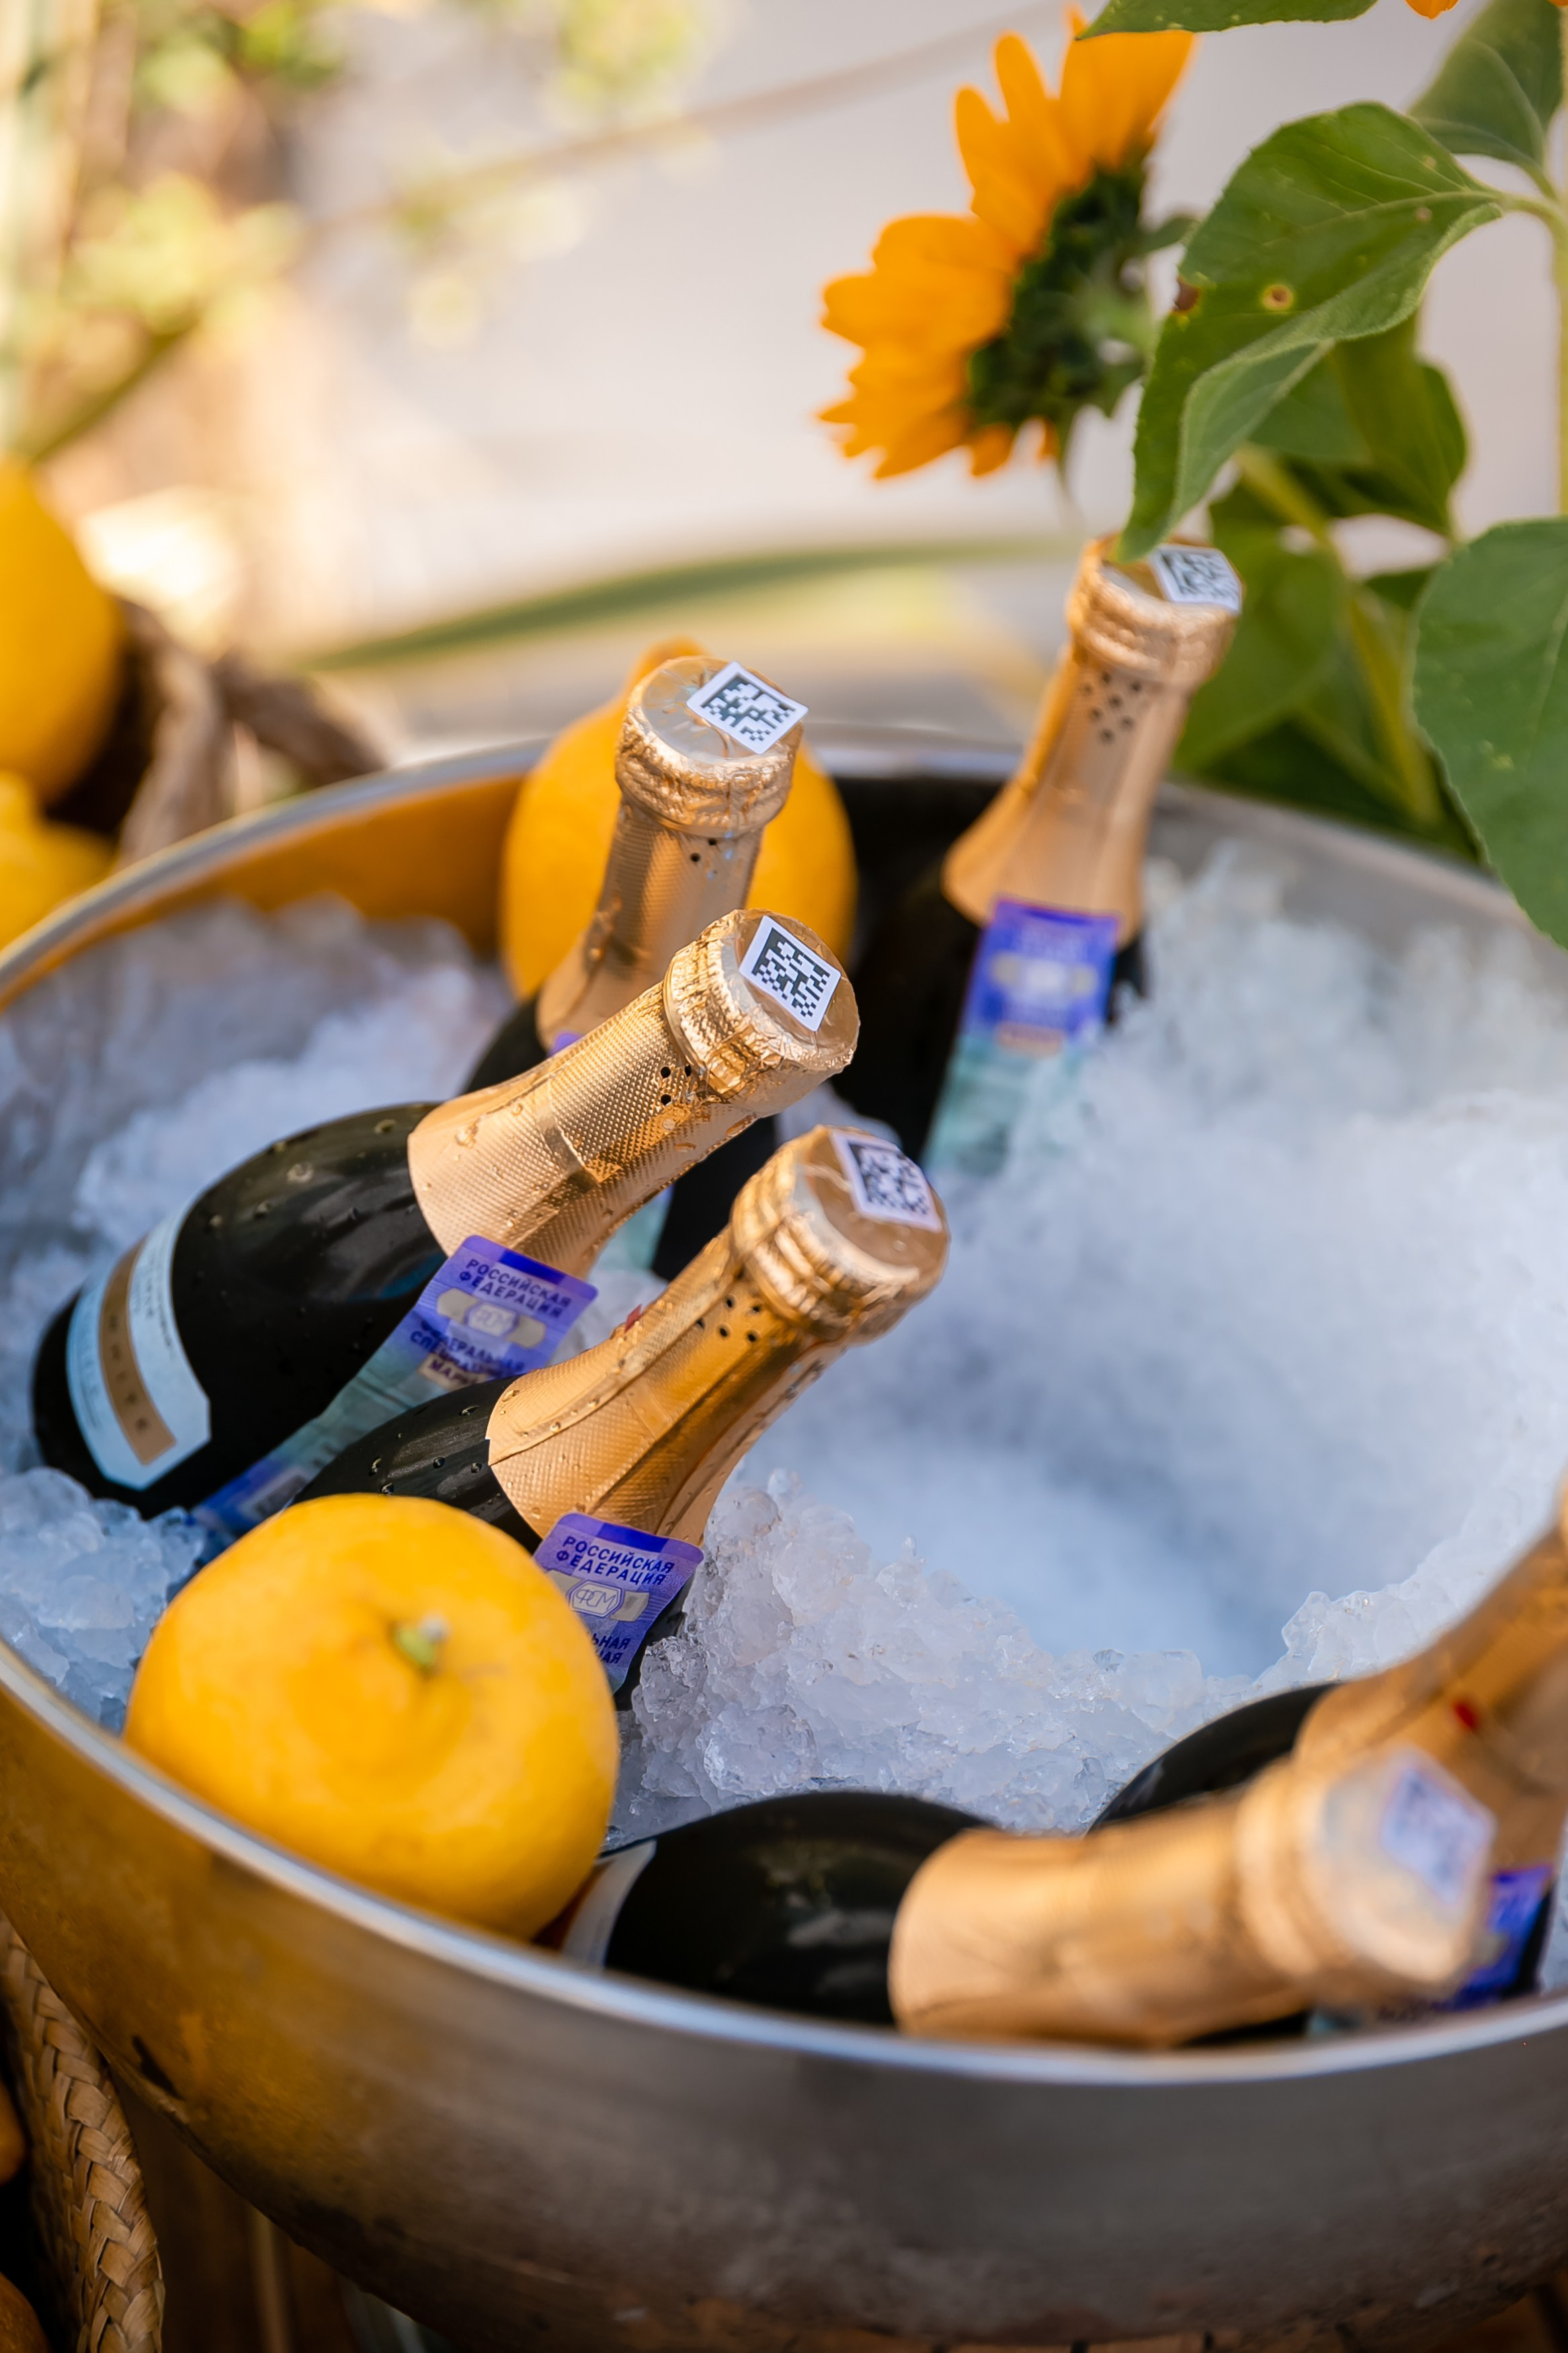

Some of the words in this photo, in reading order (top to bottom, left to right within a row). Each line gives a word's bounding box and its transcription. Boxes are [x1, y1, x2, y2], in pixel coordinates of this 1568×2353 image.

[459, 1271, 563, 1318] ФЕДЕРАЦИЯ
[466, 1259, 571, 1308] РОССИЙСКАЯ
[556, 1550, 667, 1585] ФЕДЕРАЦИЯ
[563, 1536, 675, 1574] РОССИЙСКАЯ
